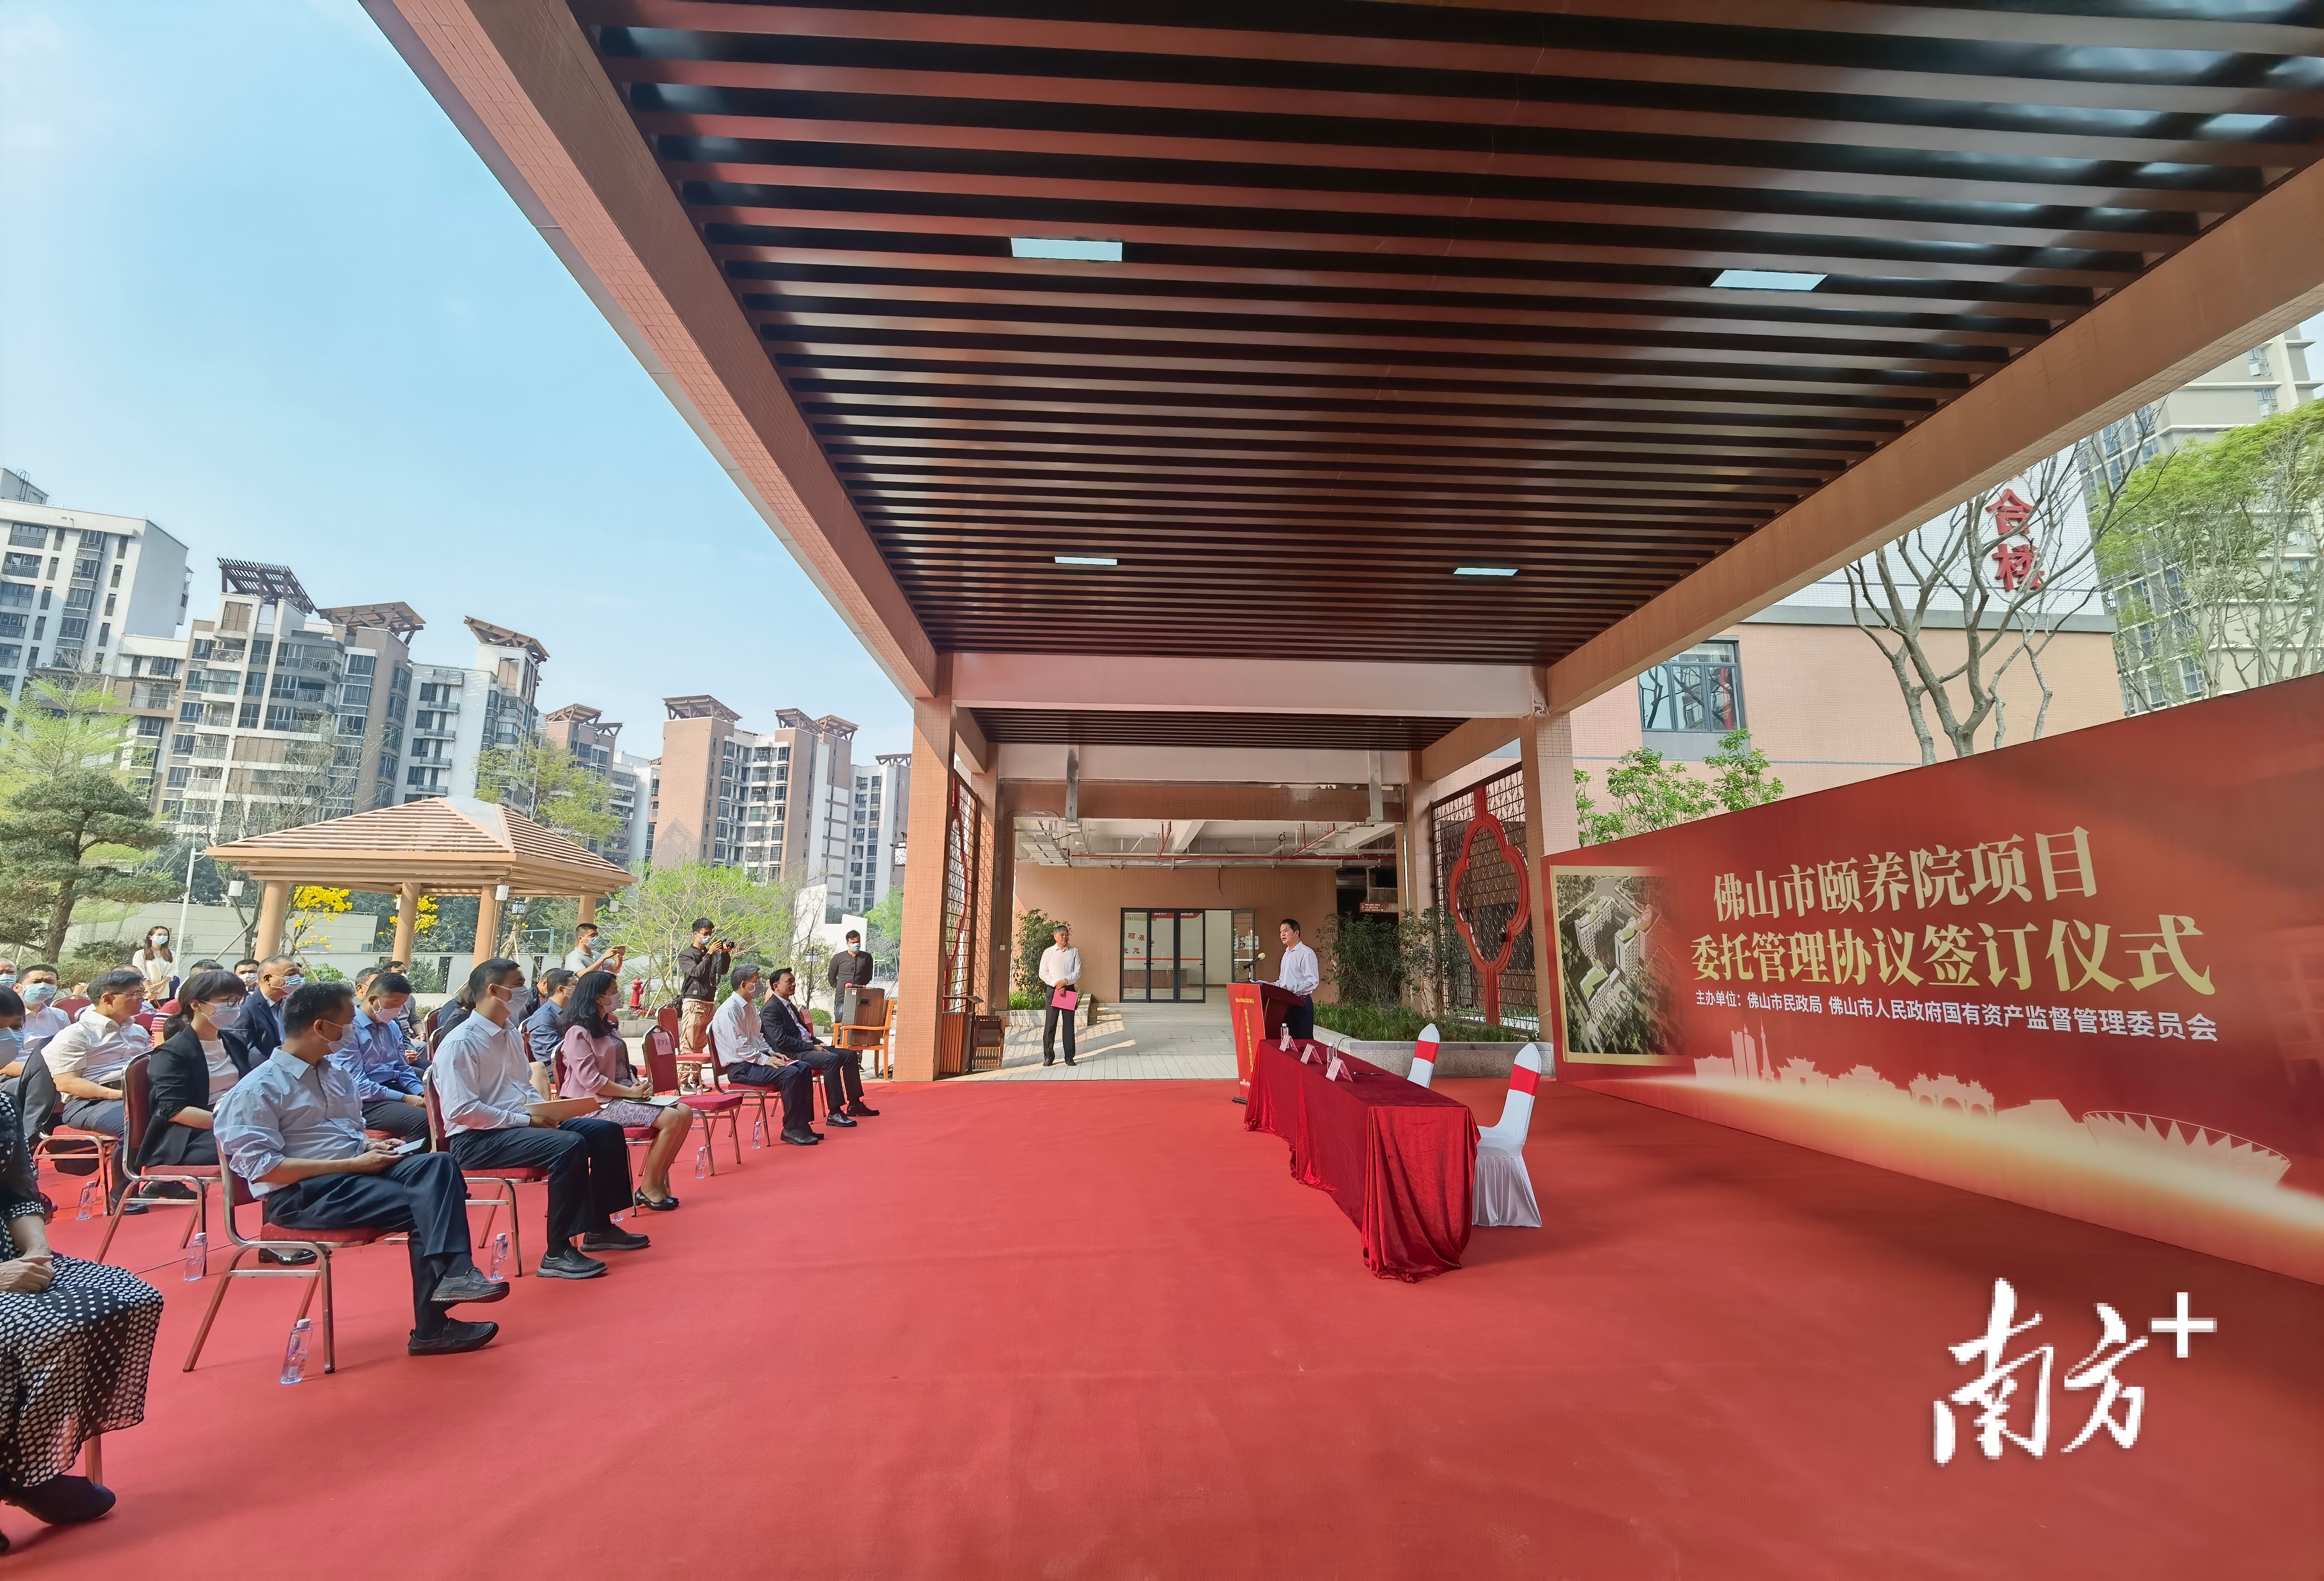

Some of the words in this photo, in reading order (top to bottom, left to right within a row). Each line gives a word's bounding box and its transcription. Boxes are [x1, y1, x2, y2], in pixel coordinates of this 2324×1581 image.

[1713, 825, 2097, 922] 佛山市颐养院项目
[1690, 913, 2216, 995] 委托管理协议签订仪式
[1828, 996, 2218, 1042] 佛山市人民政府国有资产监督管理委员会
